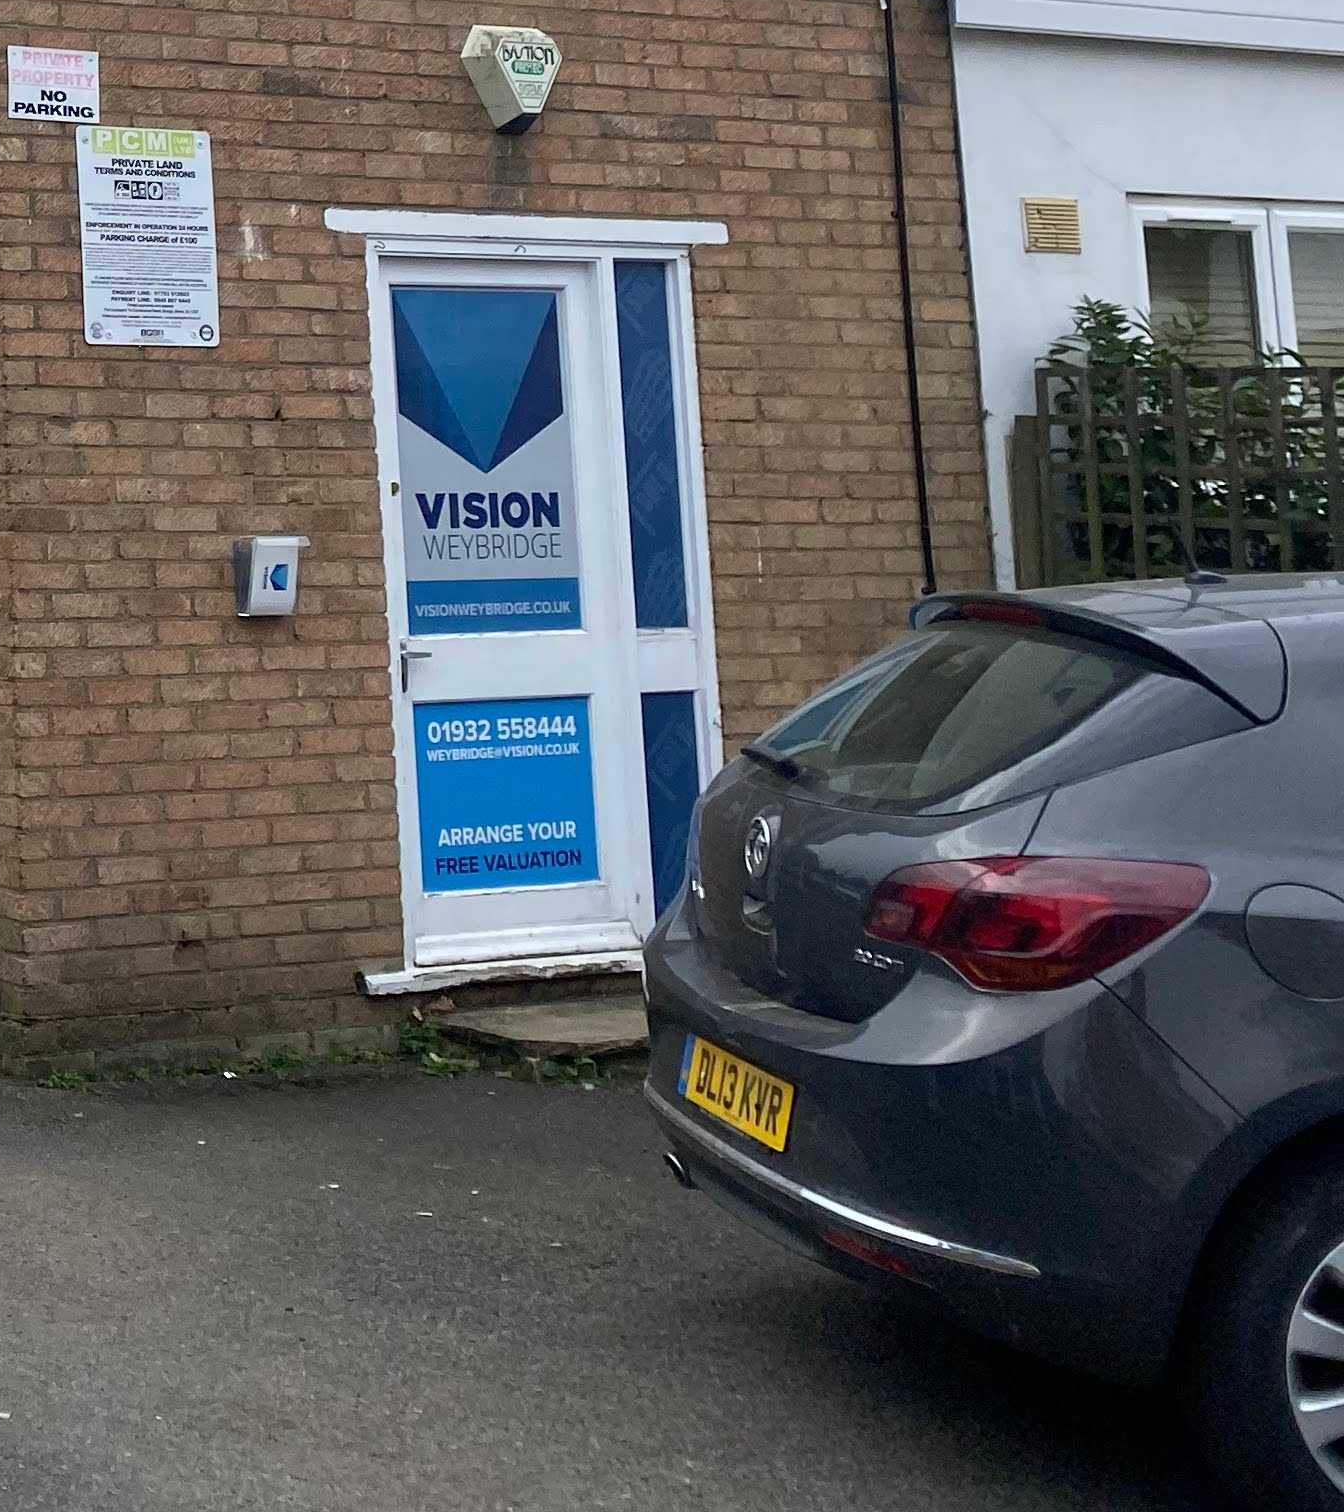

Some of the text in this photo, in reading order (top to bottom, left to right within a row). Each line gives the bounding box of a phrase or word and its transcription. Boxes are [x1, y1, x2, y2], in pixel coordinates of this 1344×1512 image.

[22, 51, 84, 68] PRIVATE
[12, 69, 95, 87] PROPERTY
[40, 90, 67, 102] NO
[14, 102, 94, 118] PARKING
[94, 167, 196, 178] TERMS AND CONDITIONS
[112, 158, 183, 170] PRIVATE LAND
[100, 234, 135, 242] PARKING
[415, 491, 561, 529] VISION
[423, 532, 562, 560] WEYBRIDGE
[415, 600, 571, 618] VISIONWEYBRIDGE.CO.UK
[427, 716, 577, 744] 01932 558444
[438, 820, 576, 848] ARRANGE YOUR
[436, 849, 582, 876] FREE VALUATION
[696, 1047, 739, 1110] DL13
